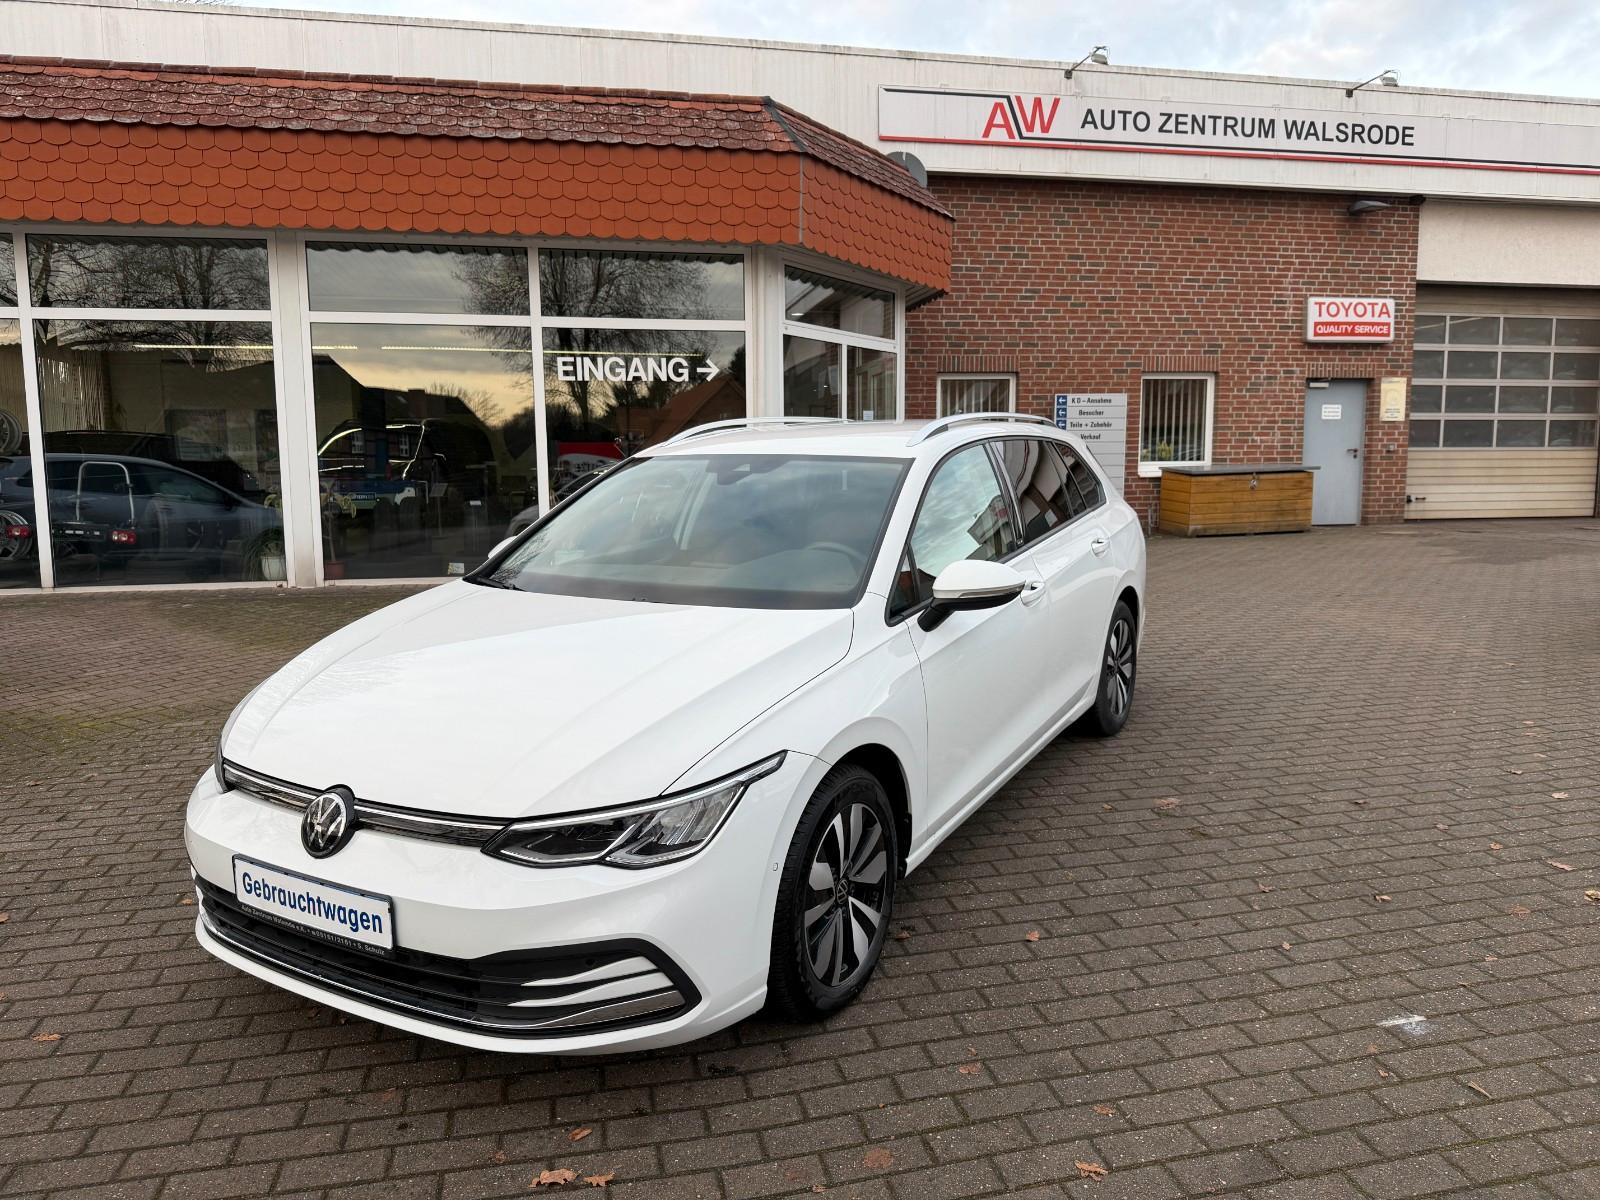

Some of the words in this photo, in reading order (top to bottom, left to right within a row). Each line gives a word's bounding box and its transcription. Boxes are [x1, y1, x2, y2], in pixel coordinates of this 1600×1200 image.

[981, 95, 1061, 140] AW
[1080, 108, 1151, 132] AUTO
[1158, 112, 1276, 139] ZENTRUM
[1283, 119, 1415, 147] WALSRODE
[1314, 301, 1391, 318] TOYOTA
[1316, 324, 1353, 334] QUALITY
[1354, 325, 1389, 334] SERVICE
[556, 356, 689, 382] EINGANG
[242, 871, 383, 933] Gebrauchtwagen
